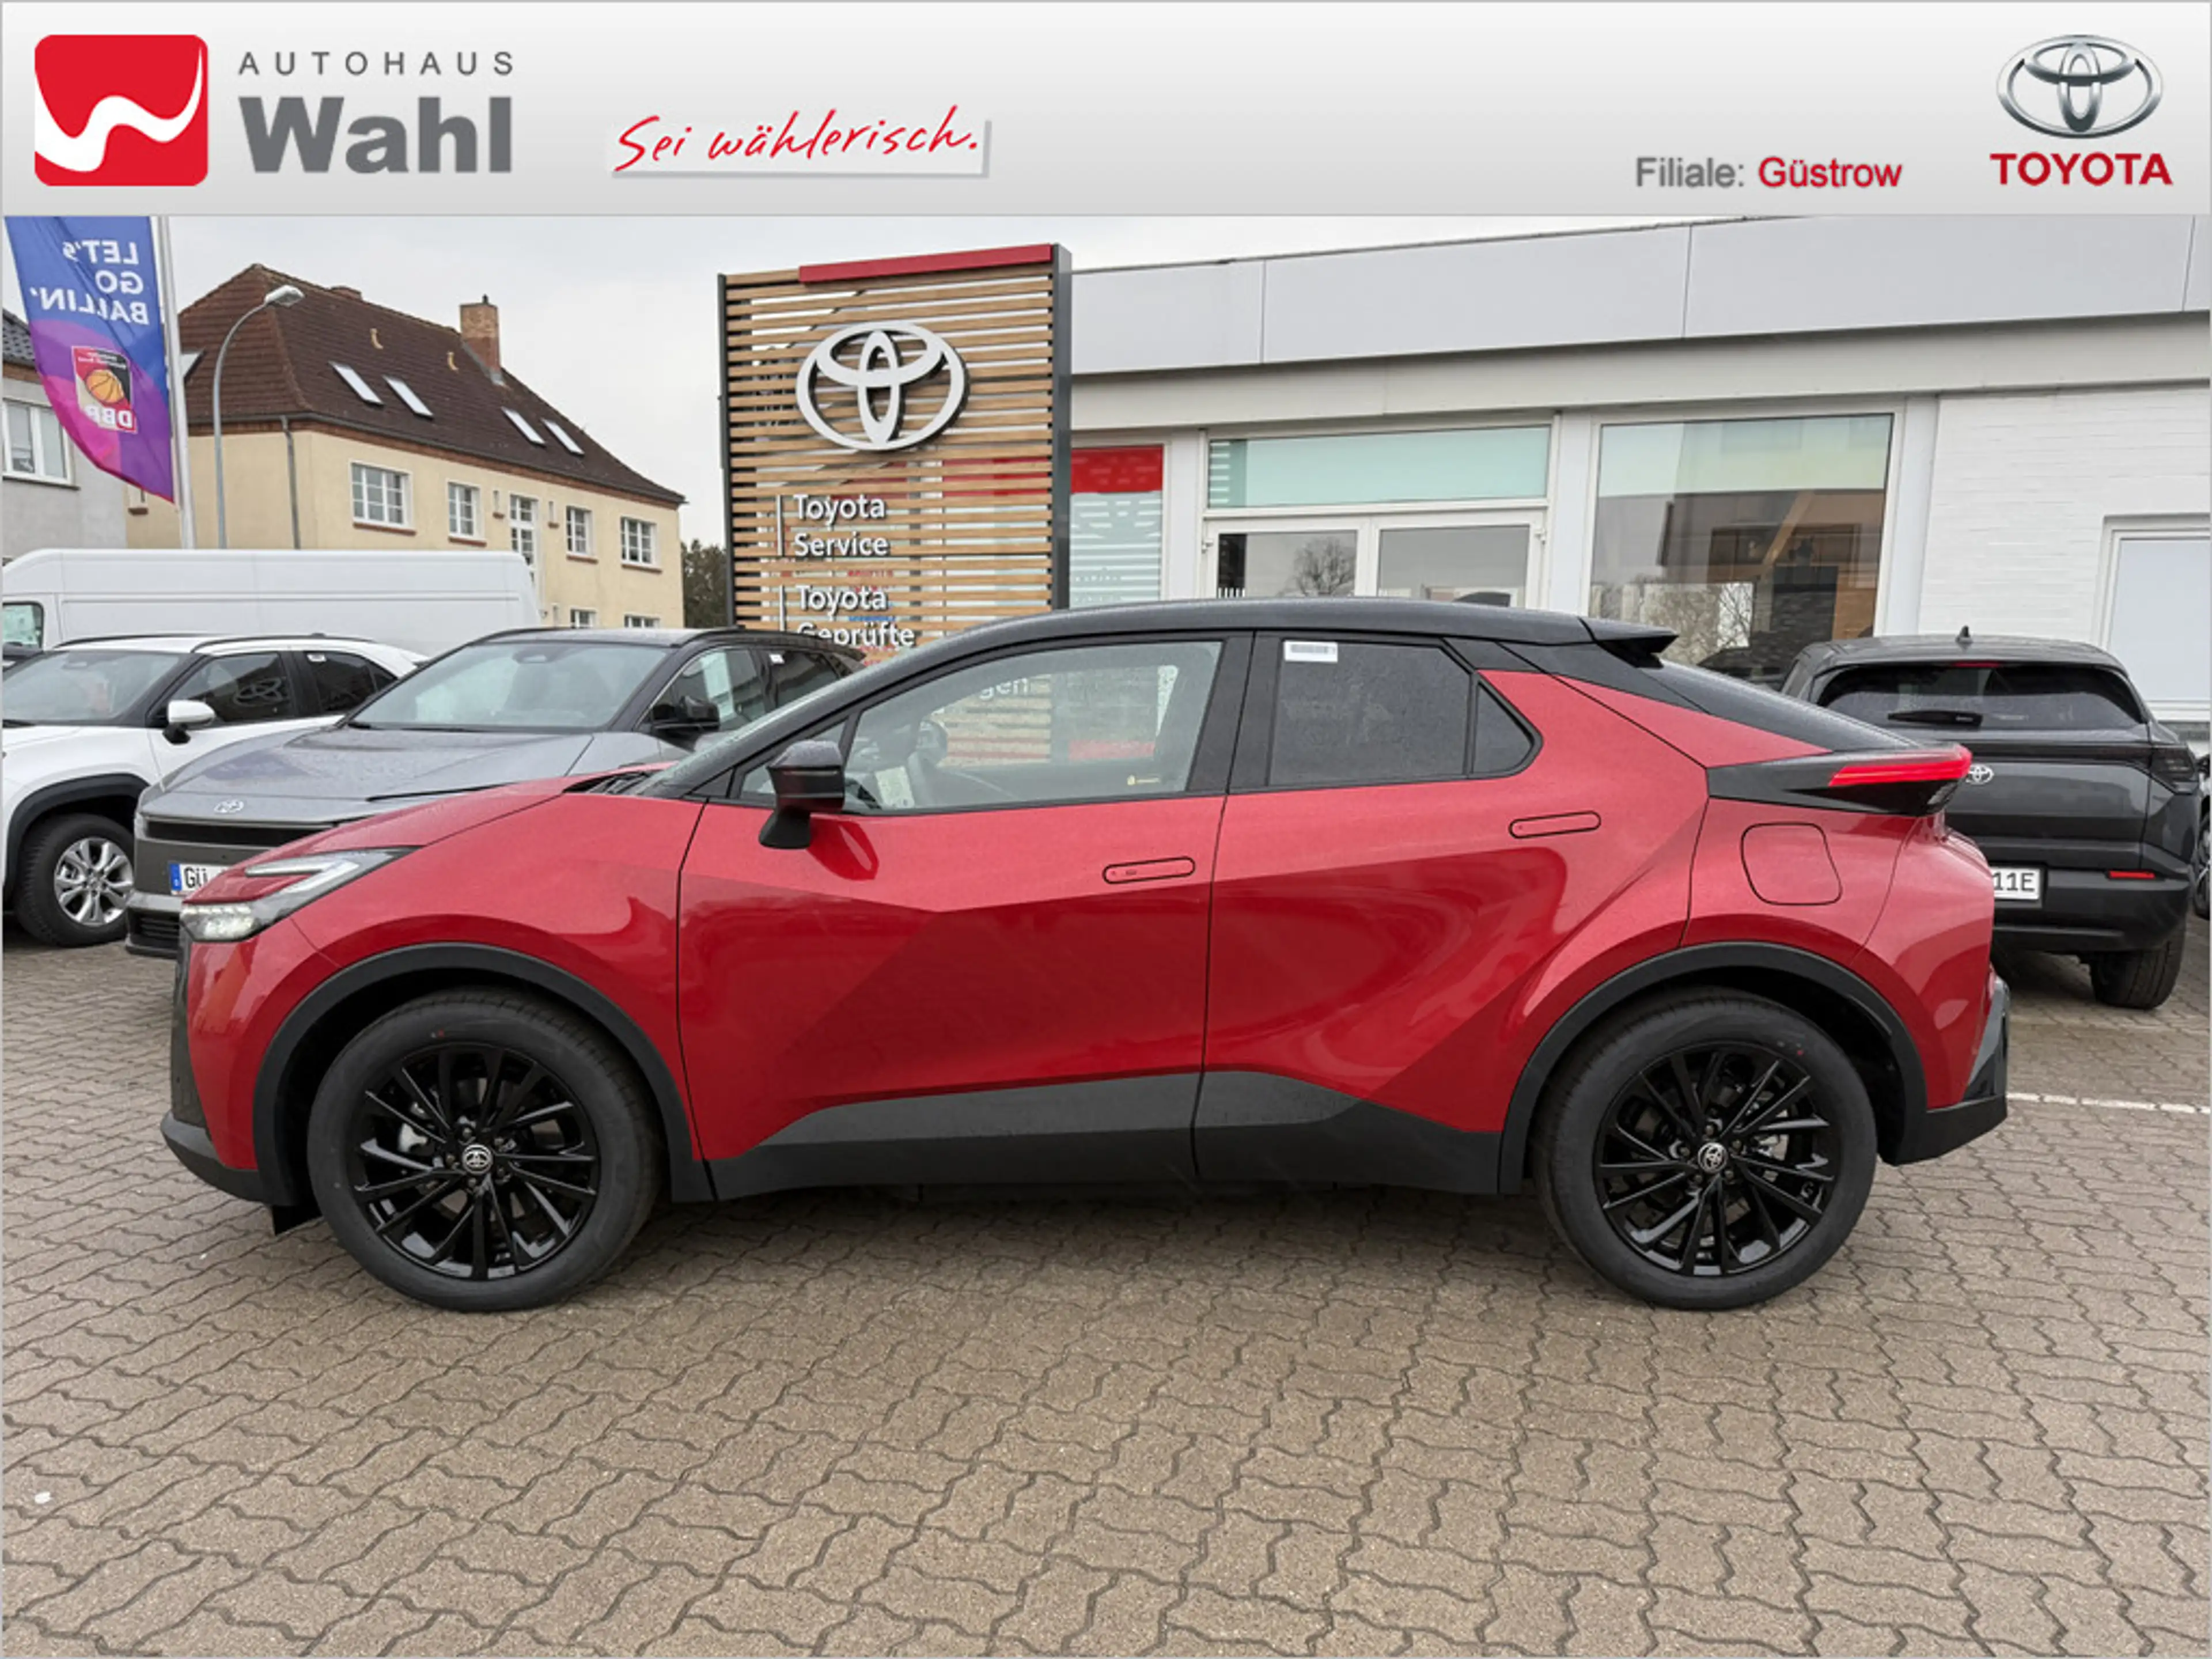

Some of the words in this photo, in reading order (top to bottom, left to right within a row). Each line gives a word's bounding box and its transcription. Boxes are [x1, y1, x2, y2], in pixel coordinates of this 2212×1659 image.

[793, 494, 886, 526] Toyota
[794, 531, 889, 556] Service
[796, 585, 888, 616] Toyota
